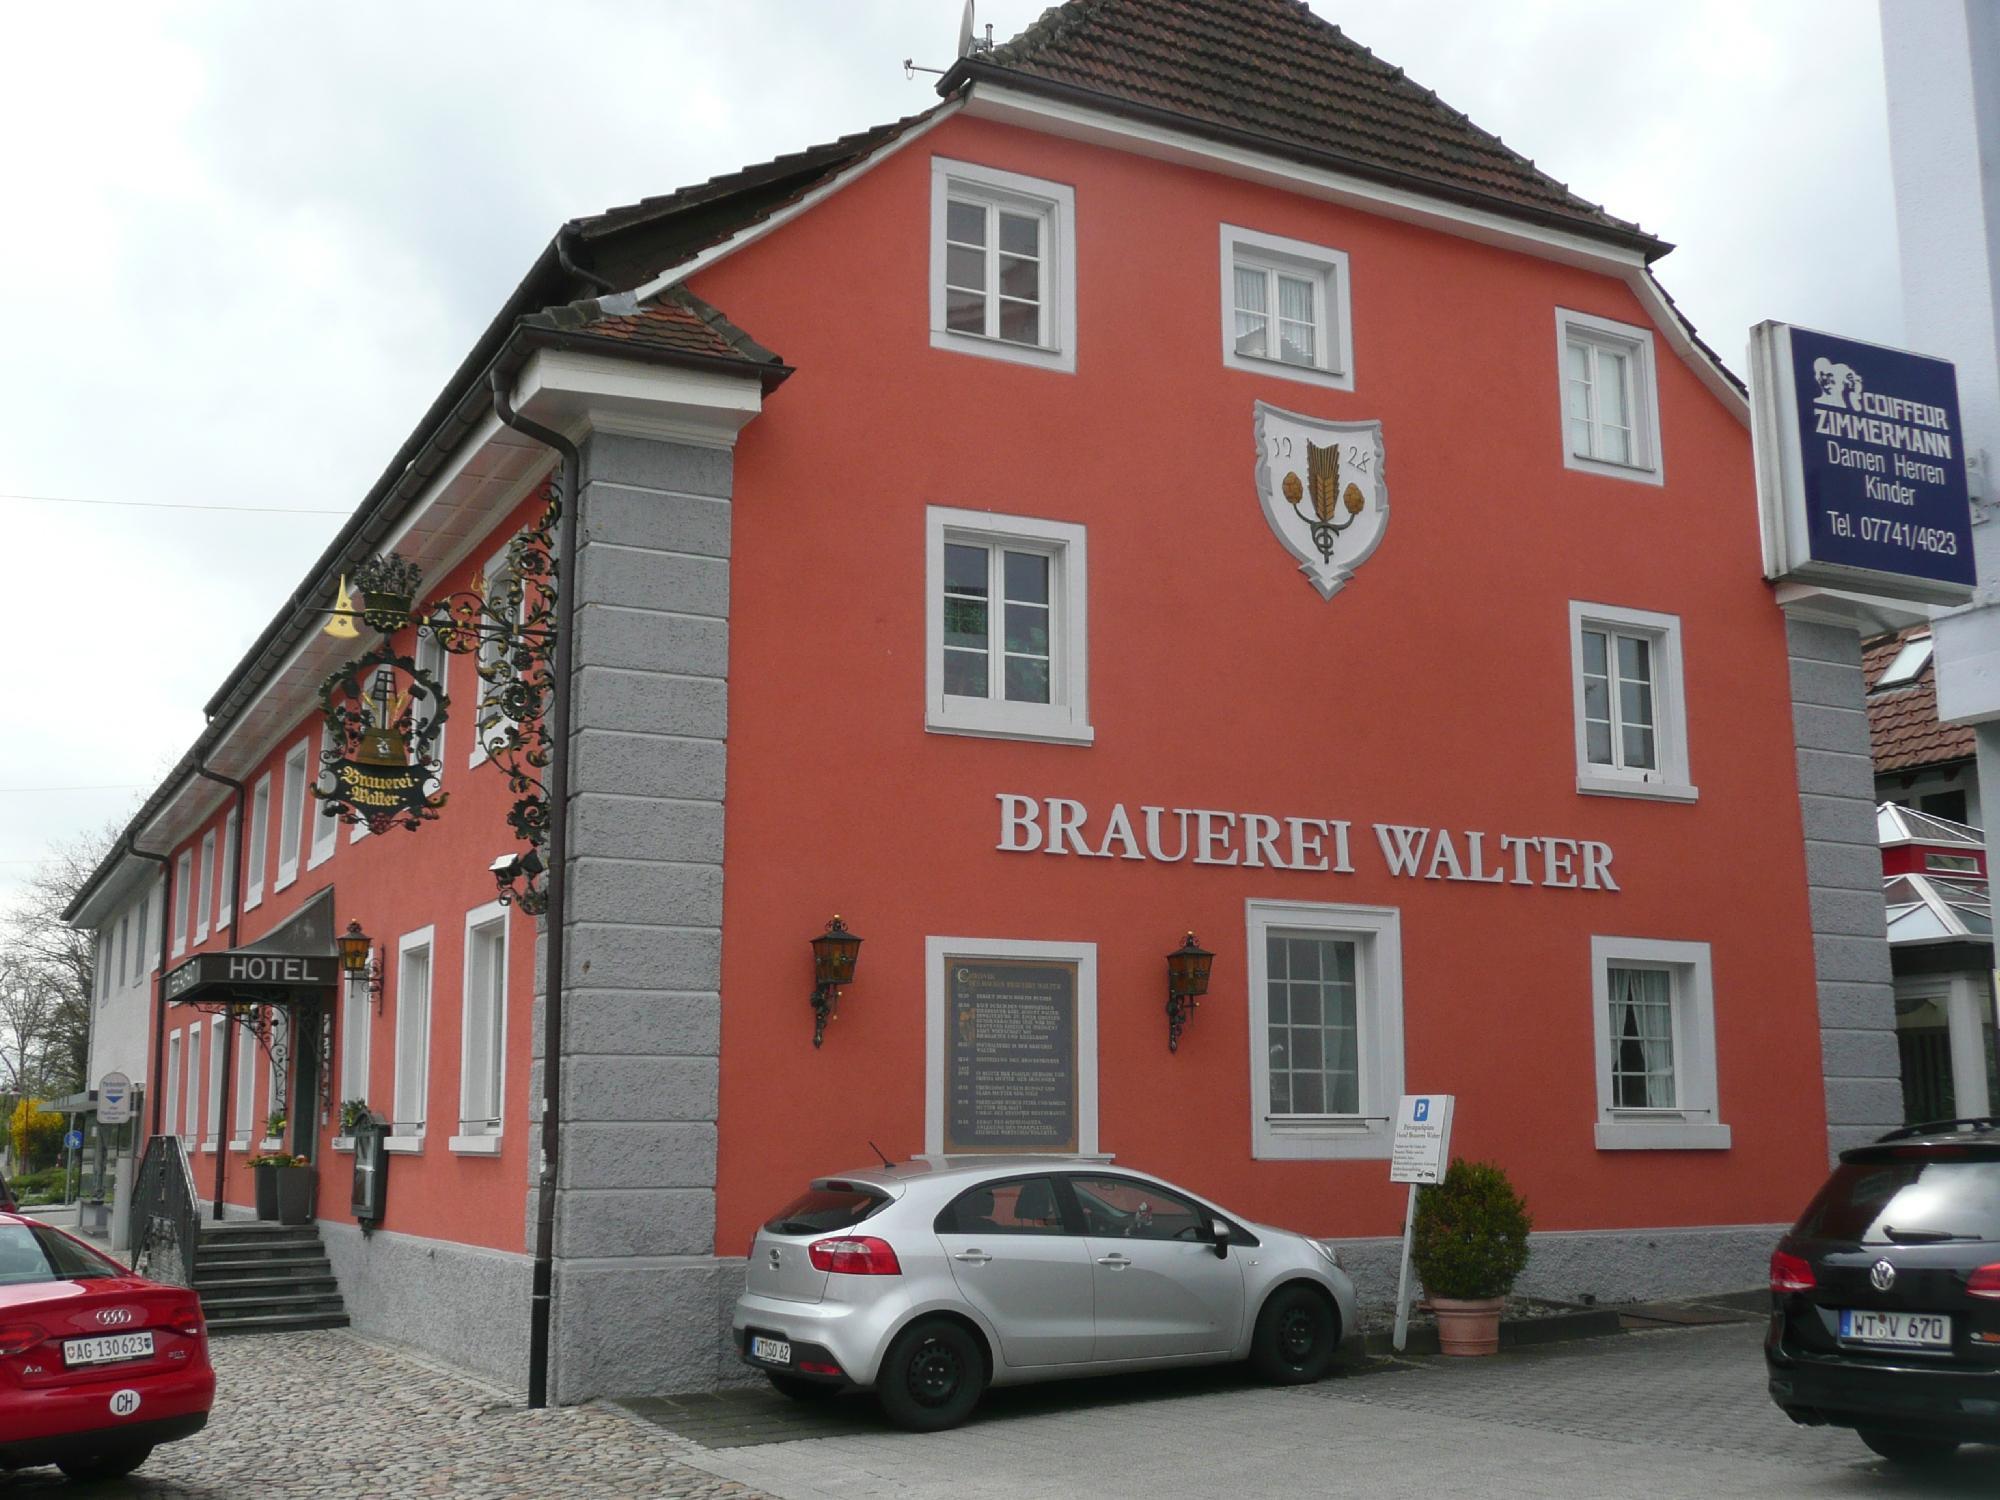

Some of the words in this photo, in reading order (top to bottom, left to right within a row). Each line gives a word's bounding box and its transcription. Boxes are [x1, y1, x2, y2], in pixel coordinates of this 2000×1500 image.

[1862, 391, 1949, 430] COIFFEUR
[1813, 408, 1952, 459] ZIMMERMANN
[1827, 440, 1886, 473] Damen
[1894, 452, 1945, 486] Herren
[1865, 474, 1916, 507] Kinder
[1826, 509, 1856, 539] Tel.
[1860, 515, 1957, 555] 07741/4623
[340, 765, 414, 789] Brauerei
[350, 785, 400, 806] Walter
[995, 792, 1356, 873] BRAUEREI
[1372, 823, 1621, 892] WALTER
[229, 956, 320, 982] HOTEL
[1854, 1315, 1876, 1336] WT
[1889, 1317, 1899, 1337] V
[1908, 1318, 1944, 1339] 670
[116, 1393, 133, 1412] CH
